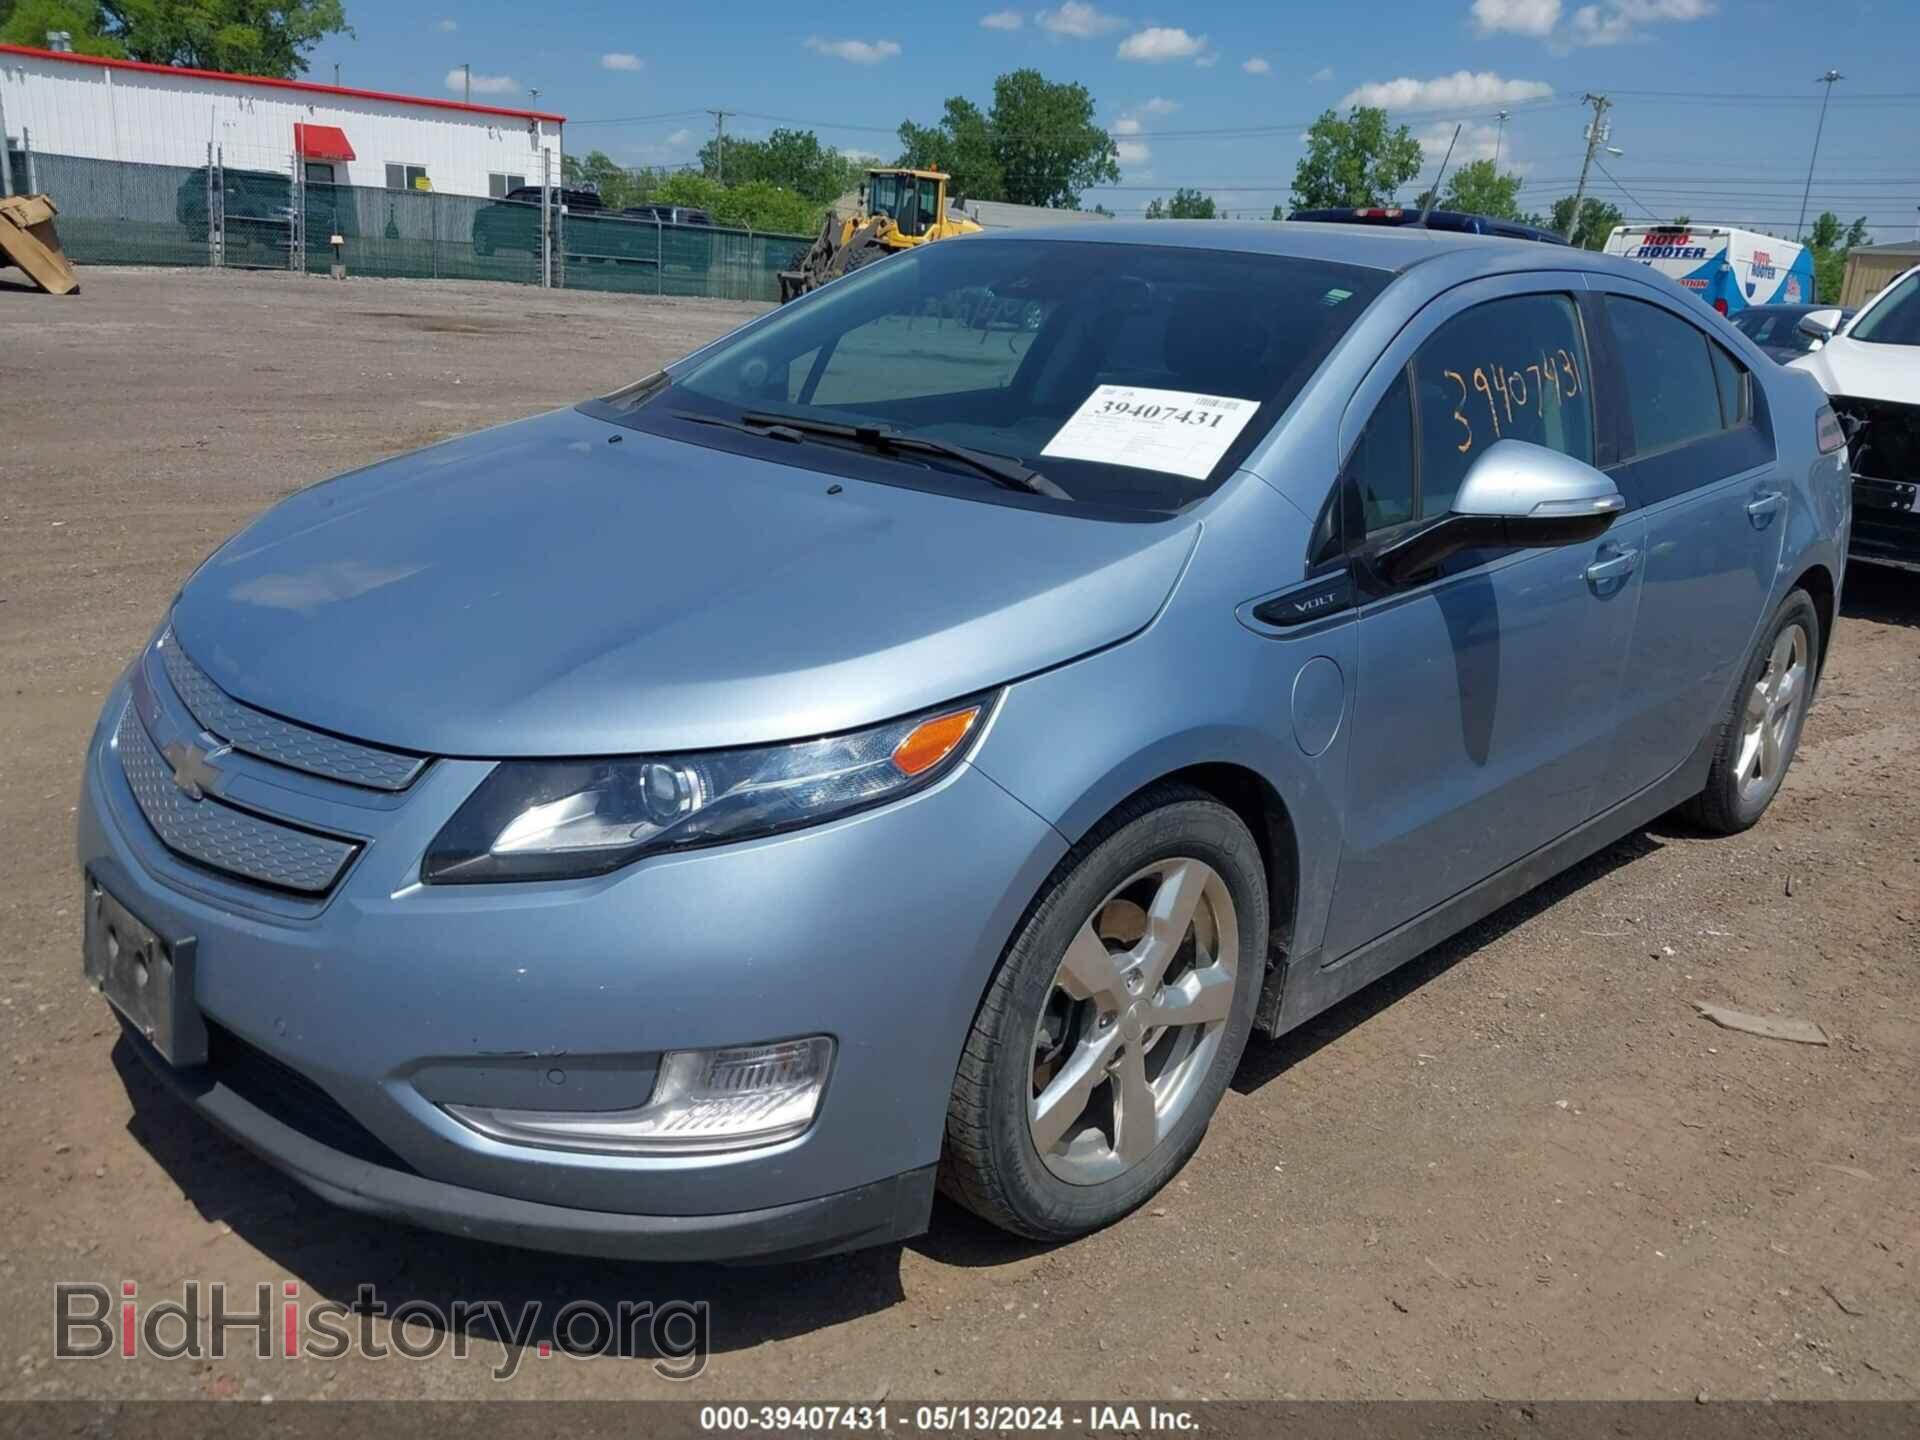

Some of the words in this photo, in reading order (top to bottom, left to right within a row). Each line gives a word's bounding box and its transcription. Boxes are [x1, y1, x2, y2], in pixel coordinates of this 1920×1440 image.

[1642, 233, 1695, 246] ROTO-
[1636, 246, 1706, 258] ROOTER
[1443, 349, 1583, 453] 39407431
[1094, 400, 1225, 428] 39407431
[1294, 592, 1337, 612] VOLT
